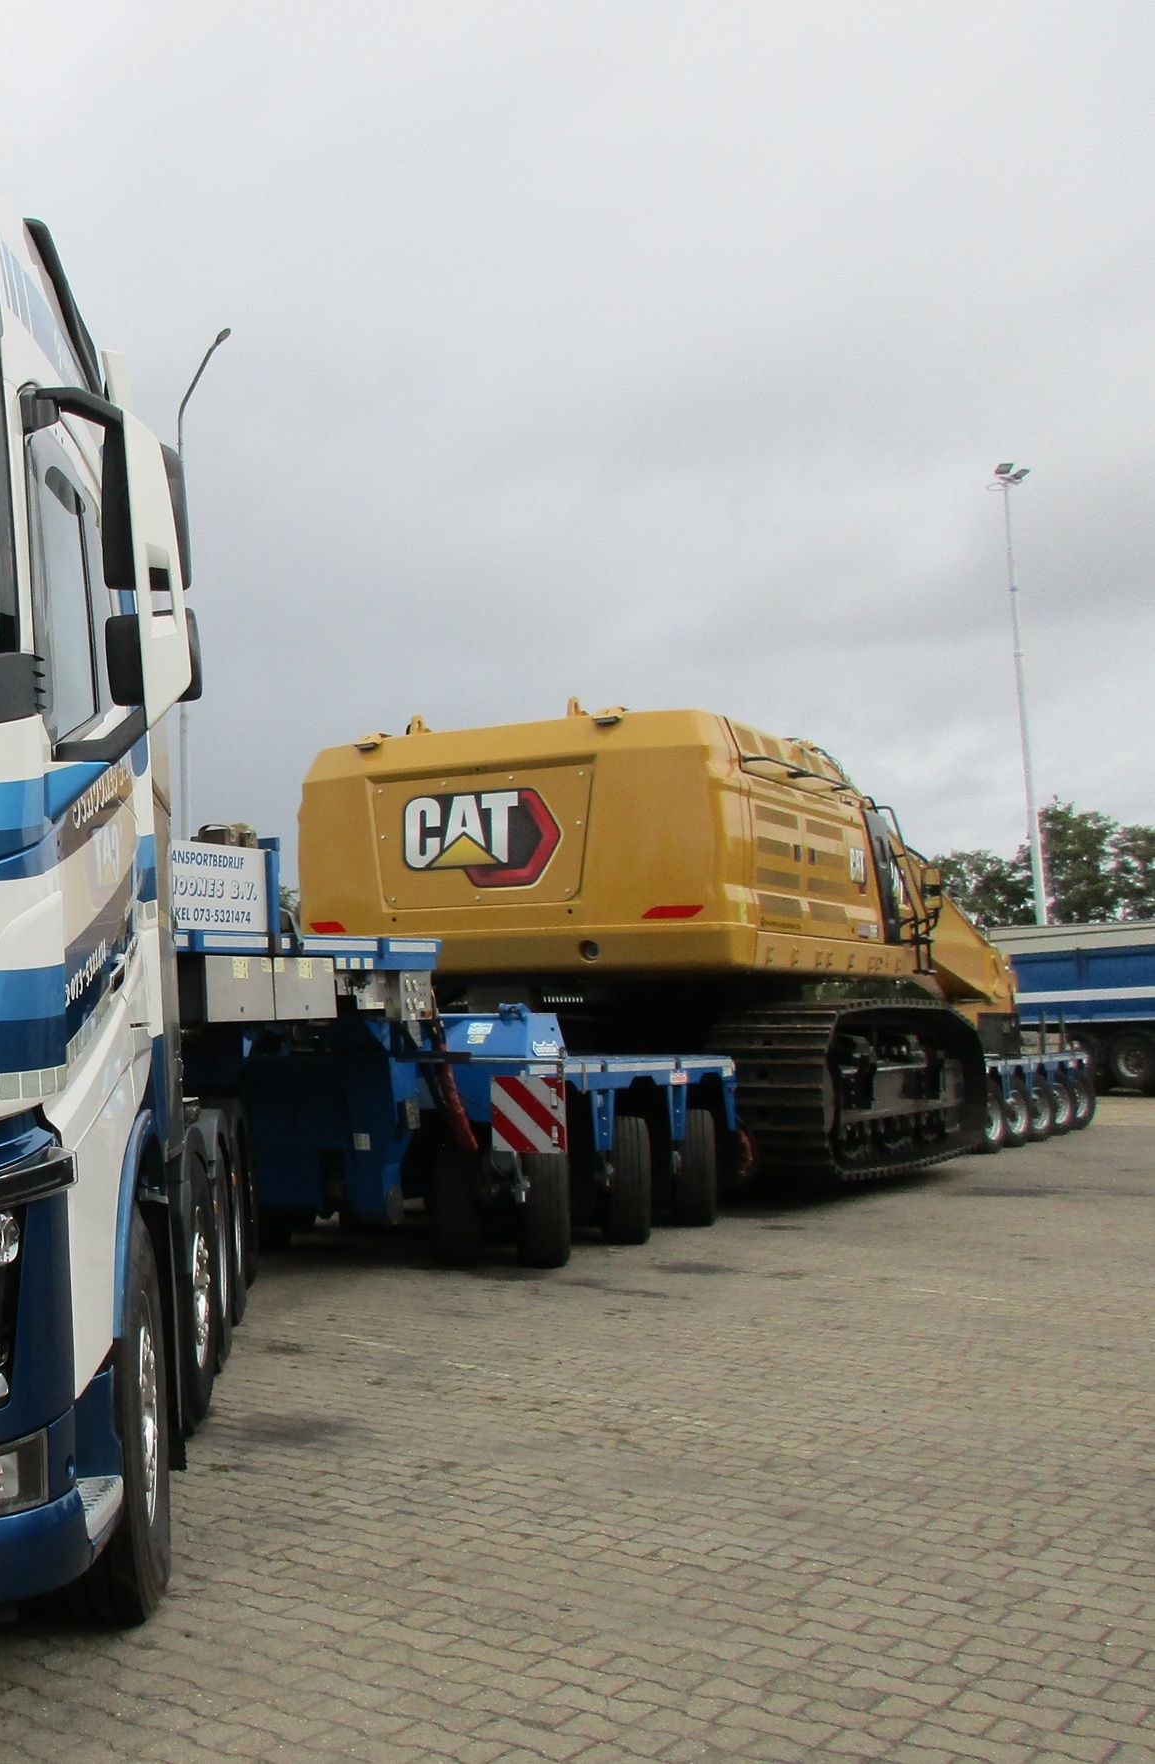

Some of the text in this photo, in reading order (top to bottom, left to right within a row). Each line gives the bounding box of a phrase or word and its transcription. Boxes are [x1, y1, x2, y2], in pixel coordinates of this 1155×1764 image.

[405, 791, 519, 869] CAT
[231, 881, 257, 900] B.V.
[193, 908, 250, 923] 073-5321474
